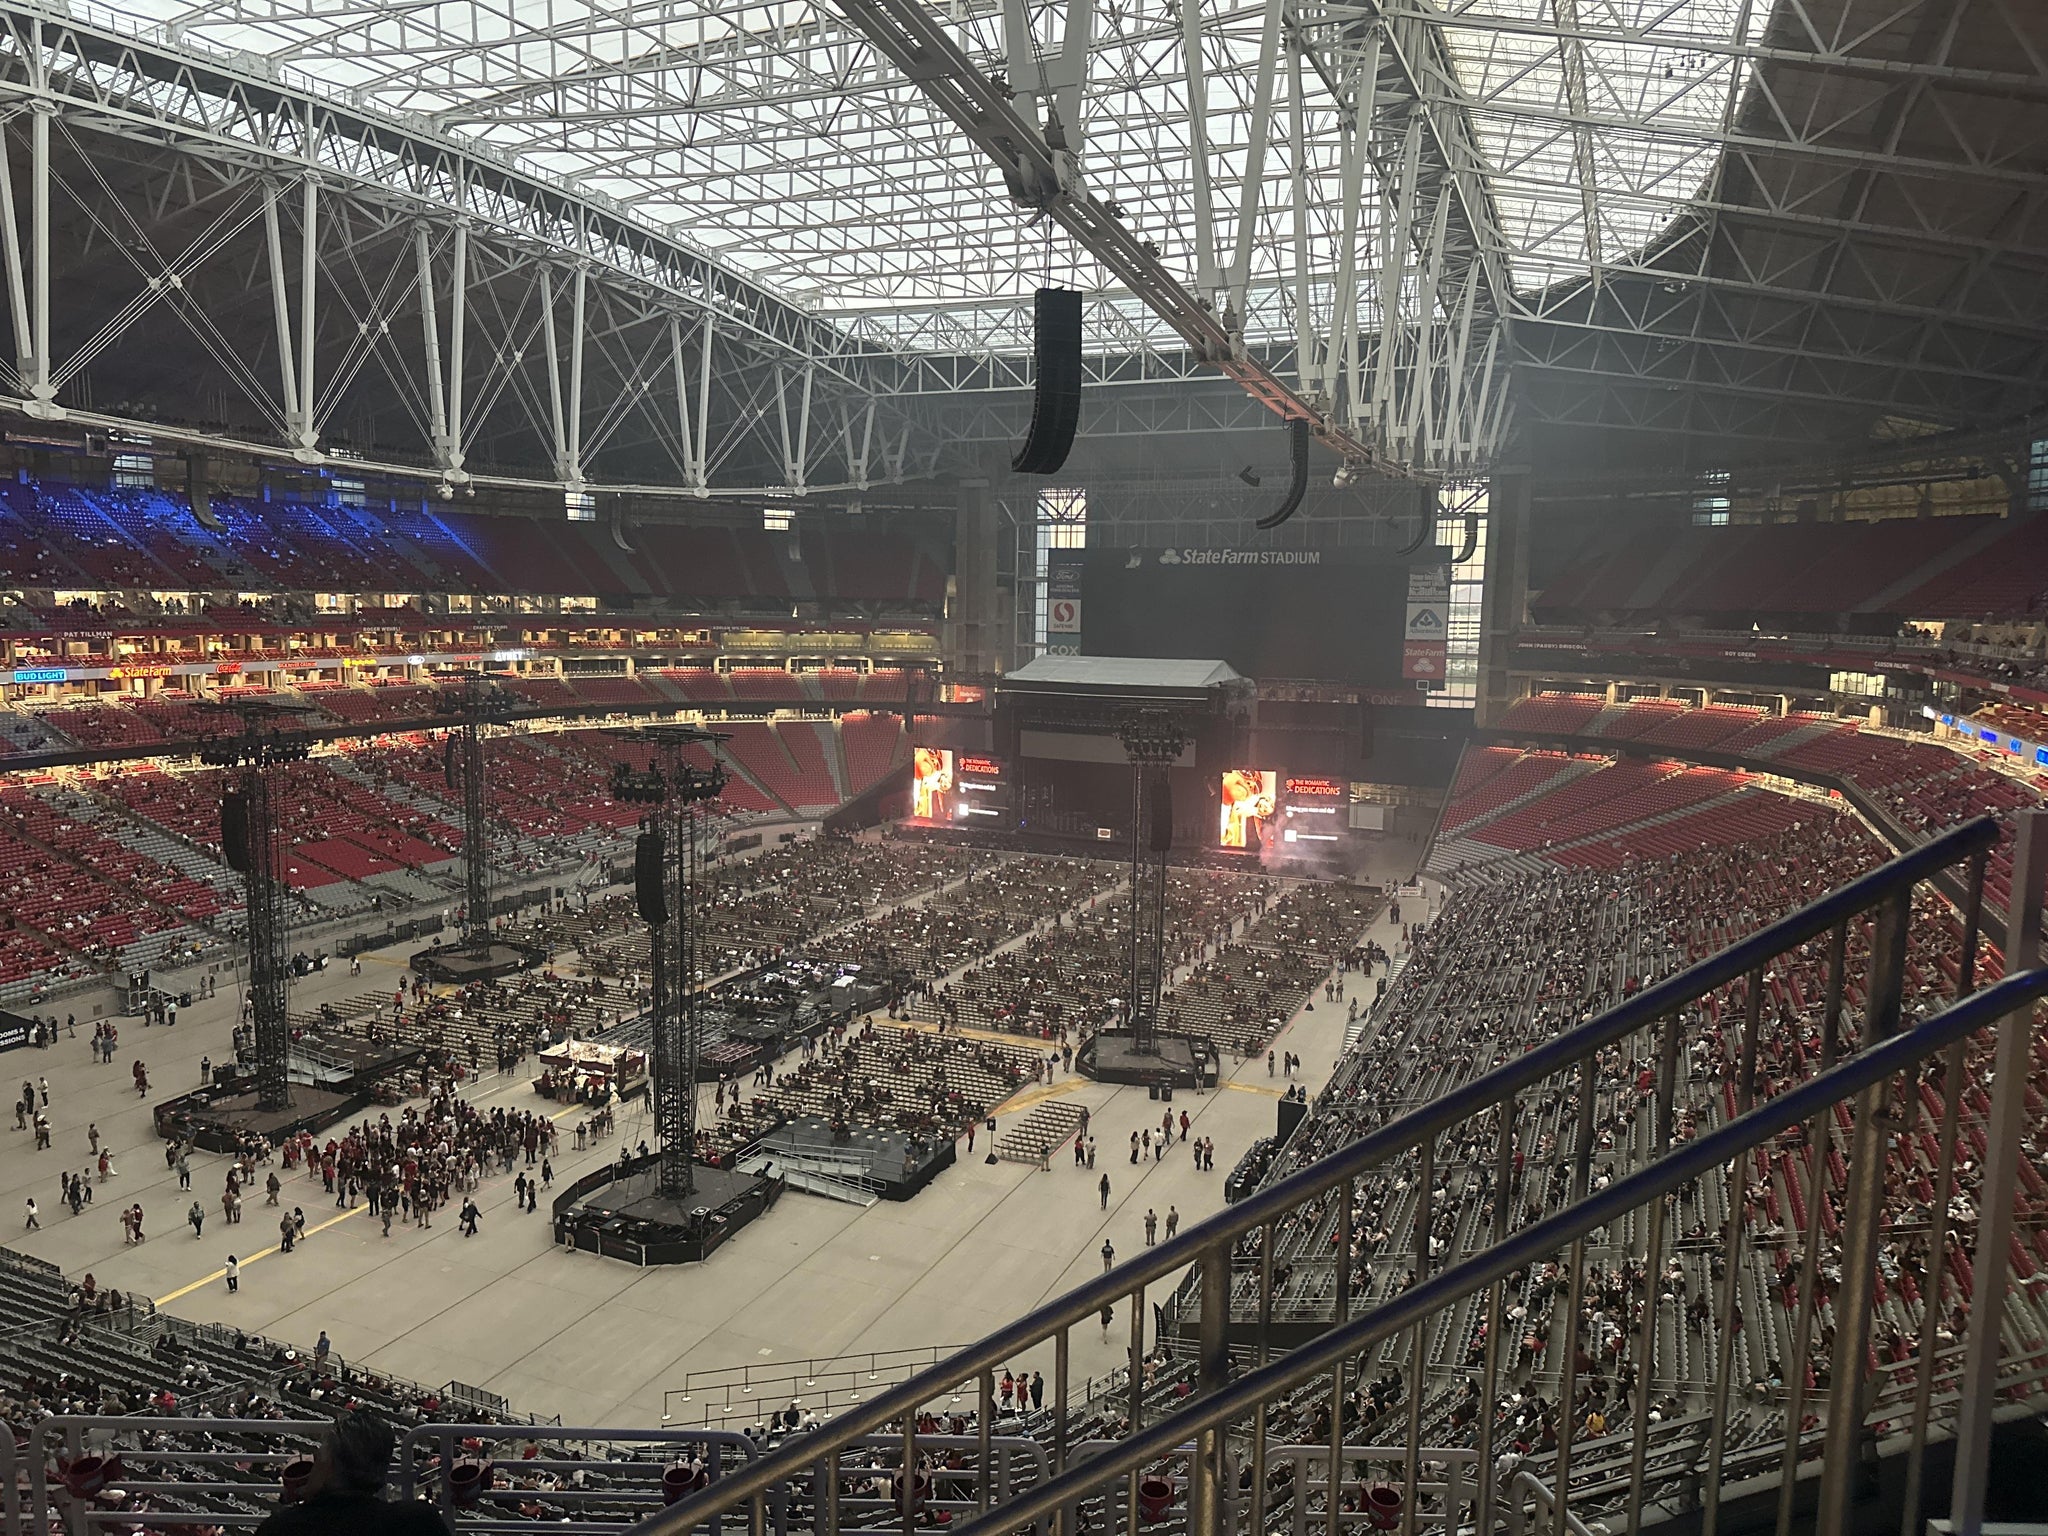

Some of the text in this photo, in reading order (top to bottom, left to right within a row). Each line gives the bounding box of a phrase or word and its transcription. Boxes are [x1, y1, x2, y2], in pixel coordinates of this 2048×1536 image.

[1261, 551, 1320, 564] STADIUM
[1049, 645, 1079, 656] COX
[16, 671, 64, 680] BUD LIGHT
[1294, 785, 1341, 796] DEDICATIONS
